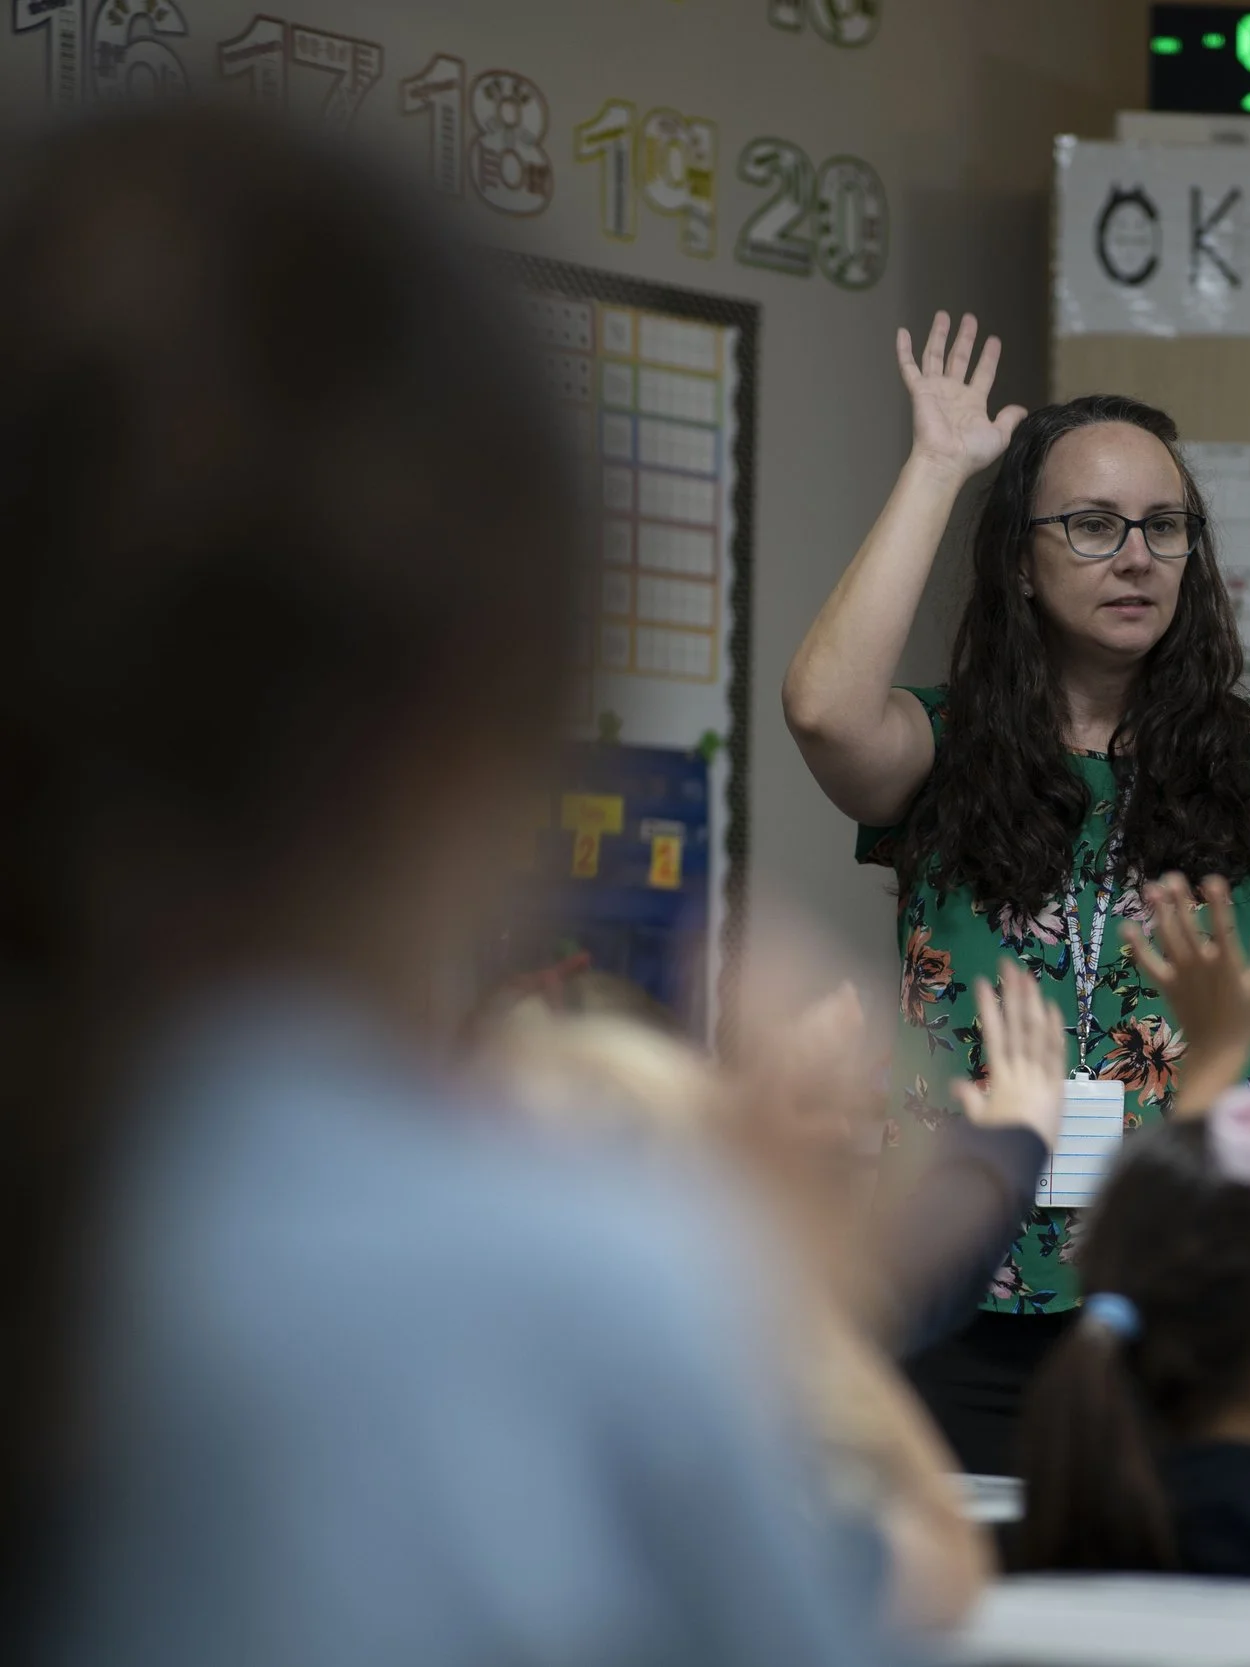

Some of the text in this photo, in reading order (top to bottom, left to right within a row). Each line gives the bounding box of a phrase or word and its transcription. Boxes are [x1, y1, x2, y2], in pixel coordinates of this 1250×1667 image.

[217, 14, 384, 130] 17
[401, 52, 555, 217] 18
[573, 97, 718, 260] 19
[735, 136, 891, 290] 20
